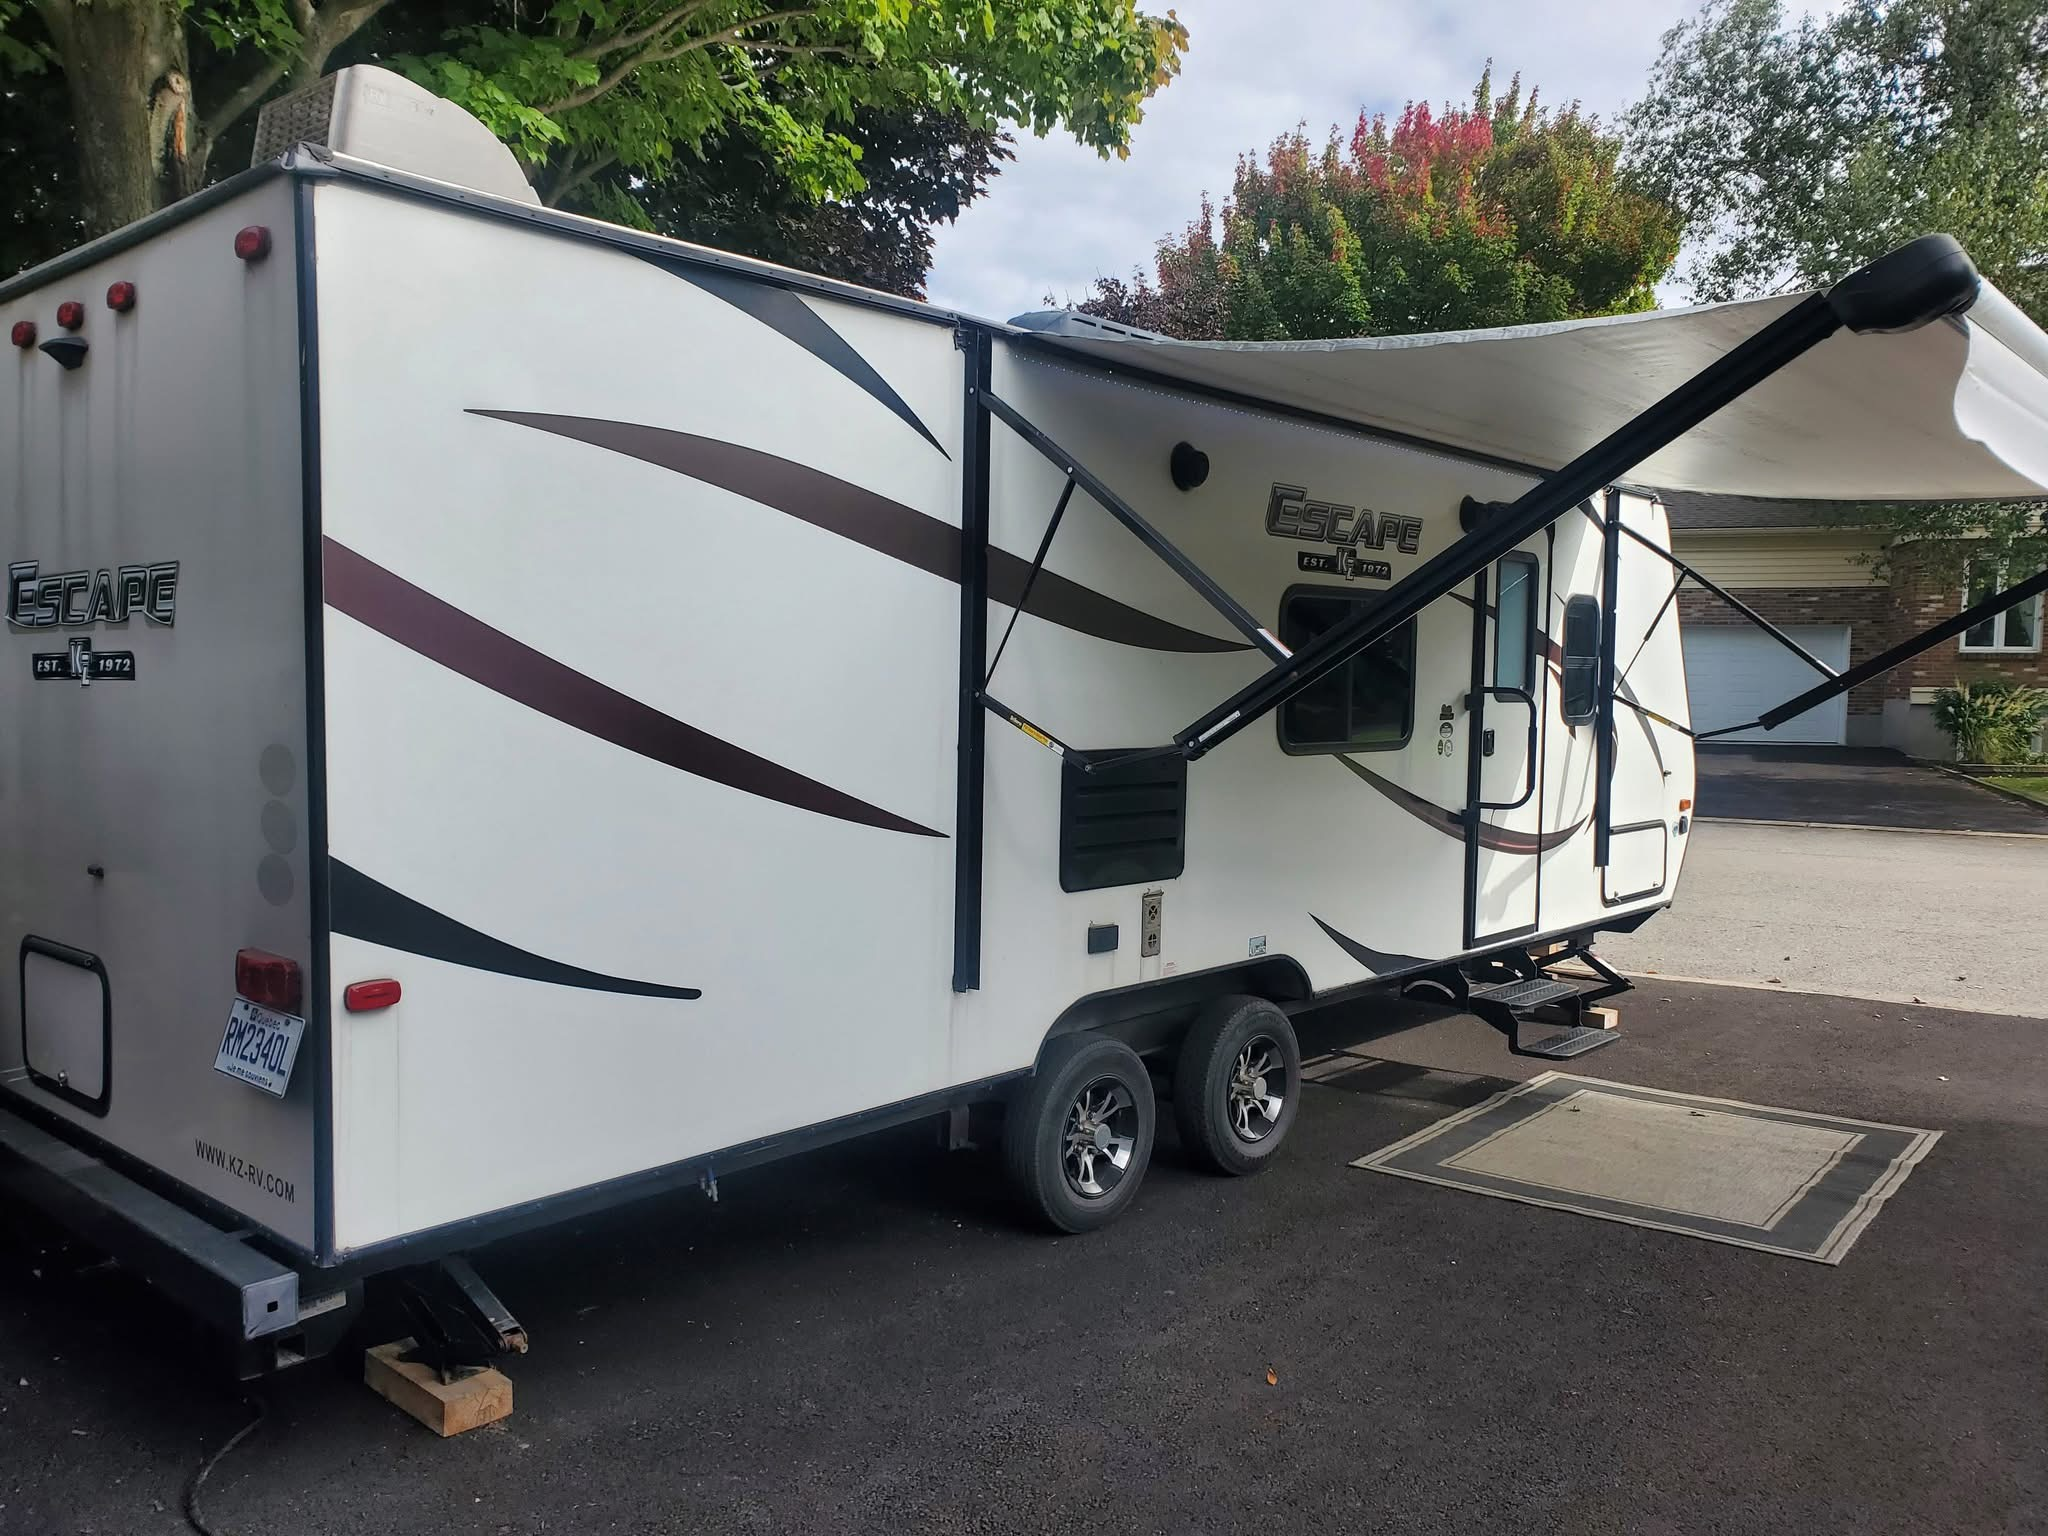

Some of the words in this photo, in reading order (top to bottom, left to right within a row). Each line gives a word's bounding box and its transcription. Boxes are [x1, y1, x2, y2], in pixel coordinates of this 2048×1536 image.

[1265, 482, 1424, 555] ESCAPE
[7, 560, 179, 627] ESCAPE
[1302, 556, 1329, 569] EST.
[1362, 563, 1389, 576] 1972
[37, 659, 62, 673] EST.
[98, 658, 131, 672] 1972
[221, 1016, 290, 1077] RM2340L
[195, 1138, 295, 1203] WWW.KZ-RV.COM
